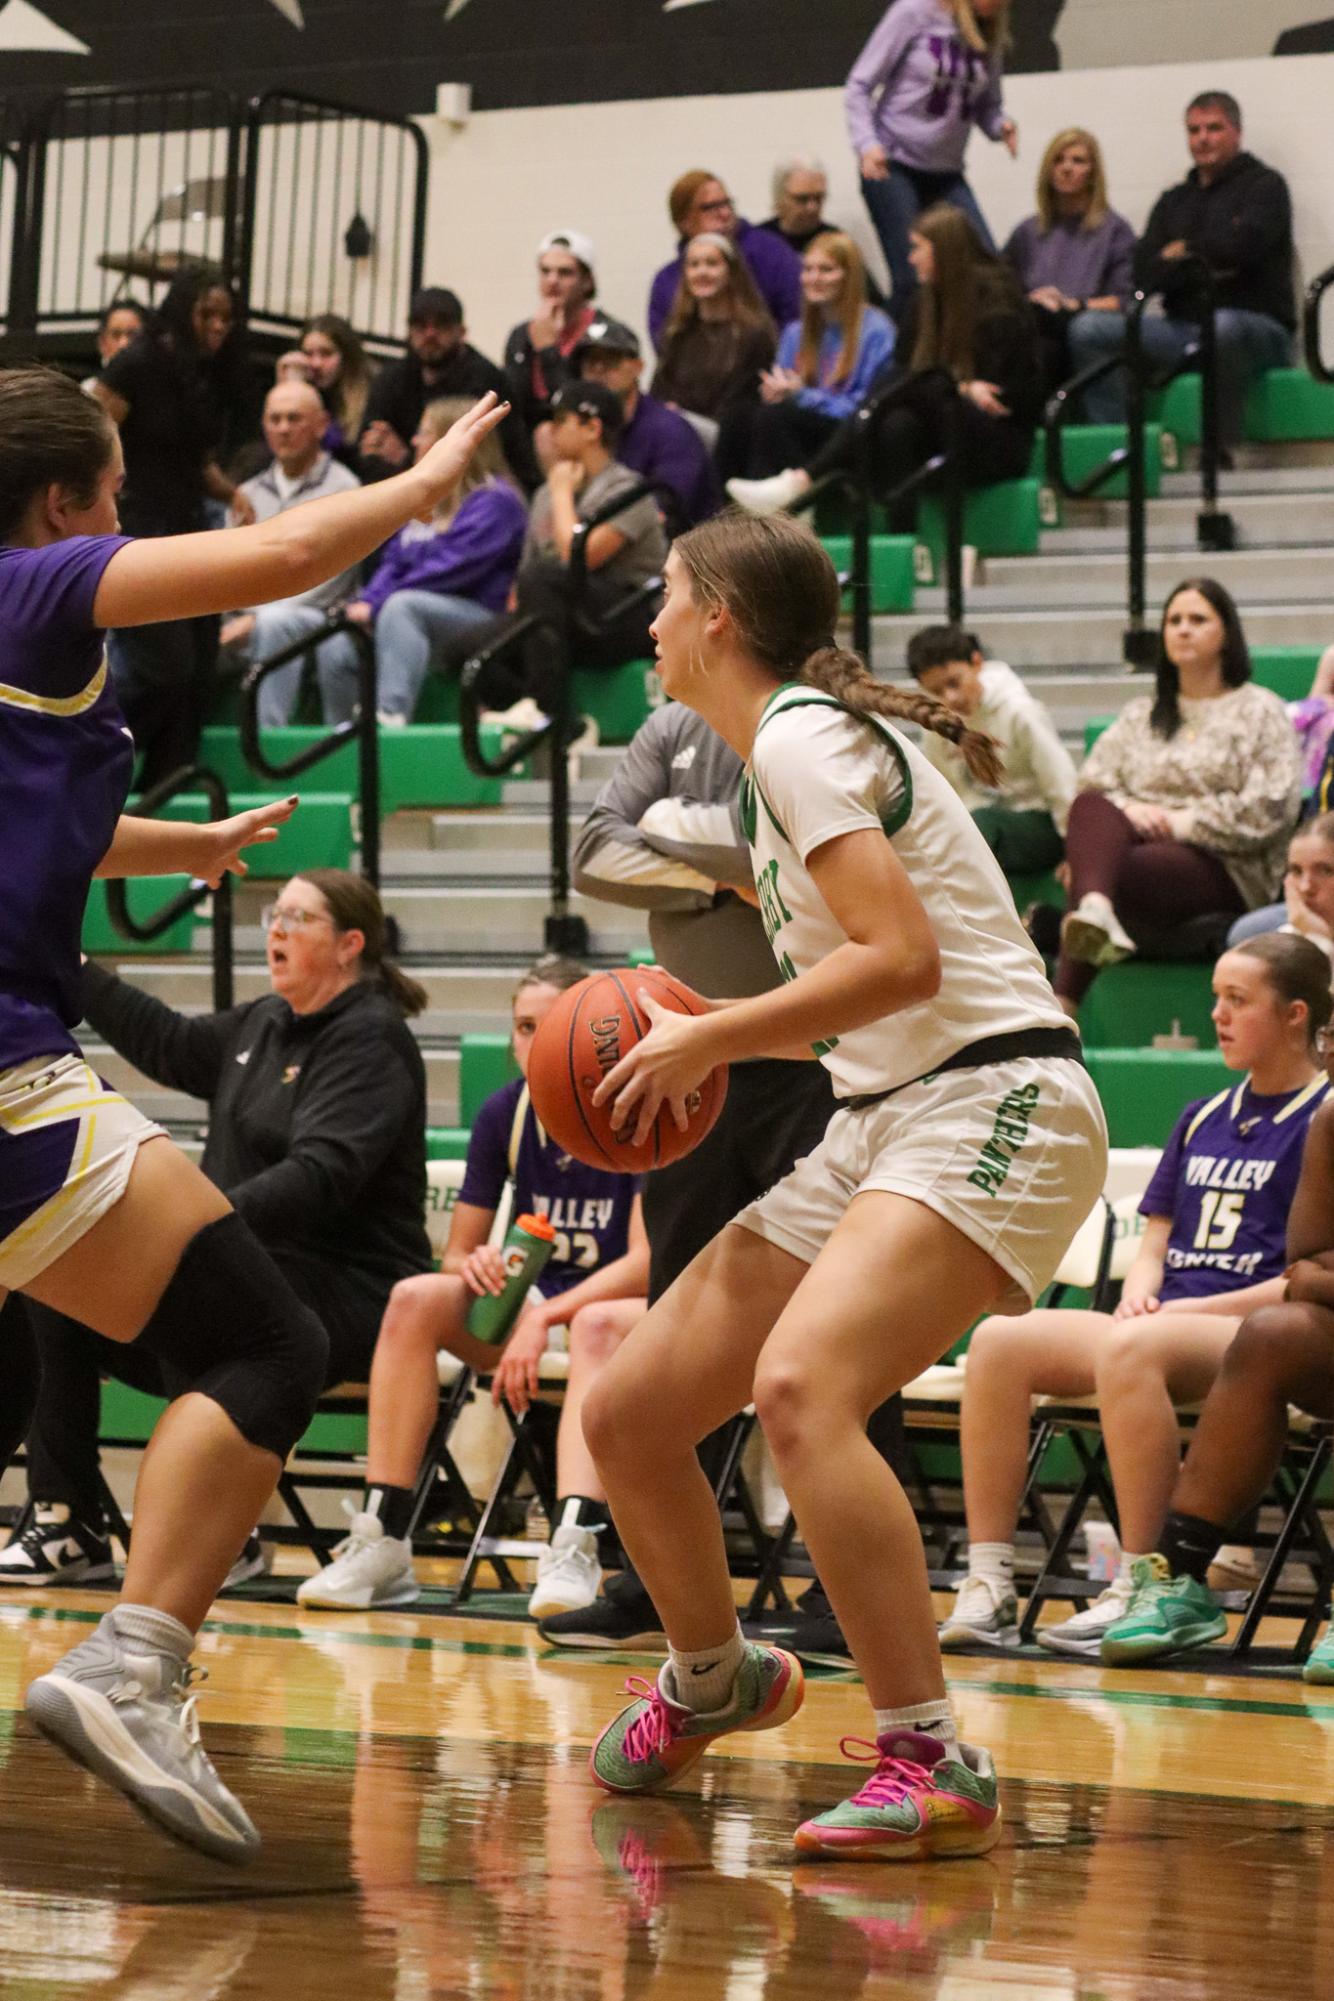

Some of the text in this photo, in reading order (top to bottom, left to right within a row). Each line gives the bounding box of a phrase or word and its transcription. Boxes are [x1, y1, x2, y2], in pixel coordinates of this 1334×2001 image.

[966, 1083, 1040, 1198] PANTHERS
[1186, 1155, 1277, 1191] VALLEY
[1193, 1190, 1246, 1250] 15
